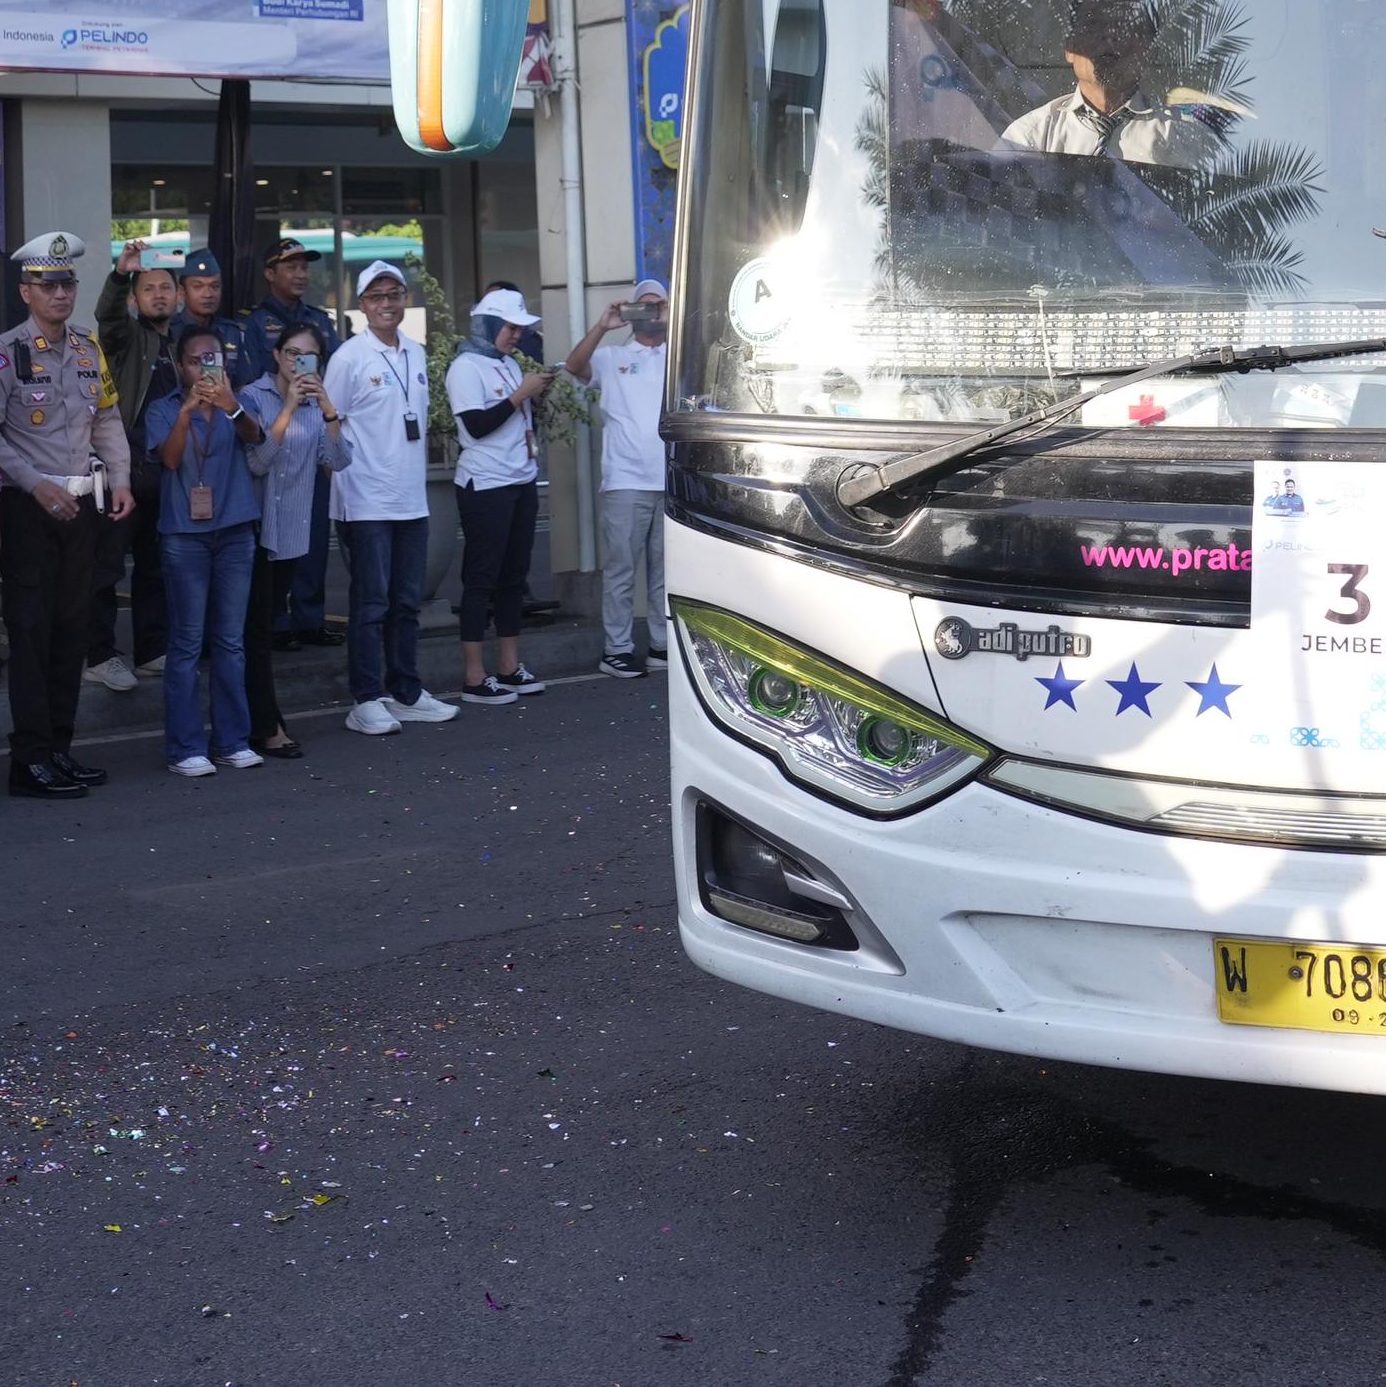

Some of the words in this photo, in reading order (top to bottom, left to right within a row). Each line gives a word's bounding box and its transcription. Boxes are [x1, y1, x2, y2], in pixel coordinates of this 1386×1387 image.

[3, 29, 54, 42] Indonesia
[81, 29, 148, 44] PELINDO
[754, 279, 772, 303] A
[1324, 563, 1372, 625] 3
[1221, 947, 1248, 993] W
